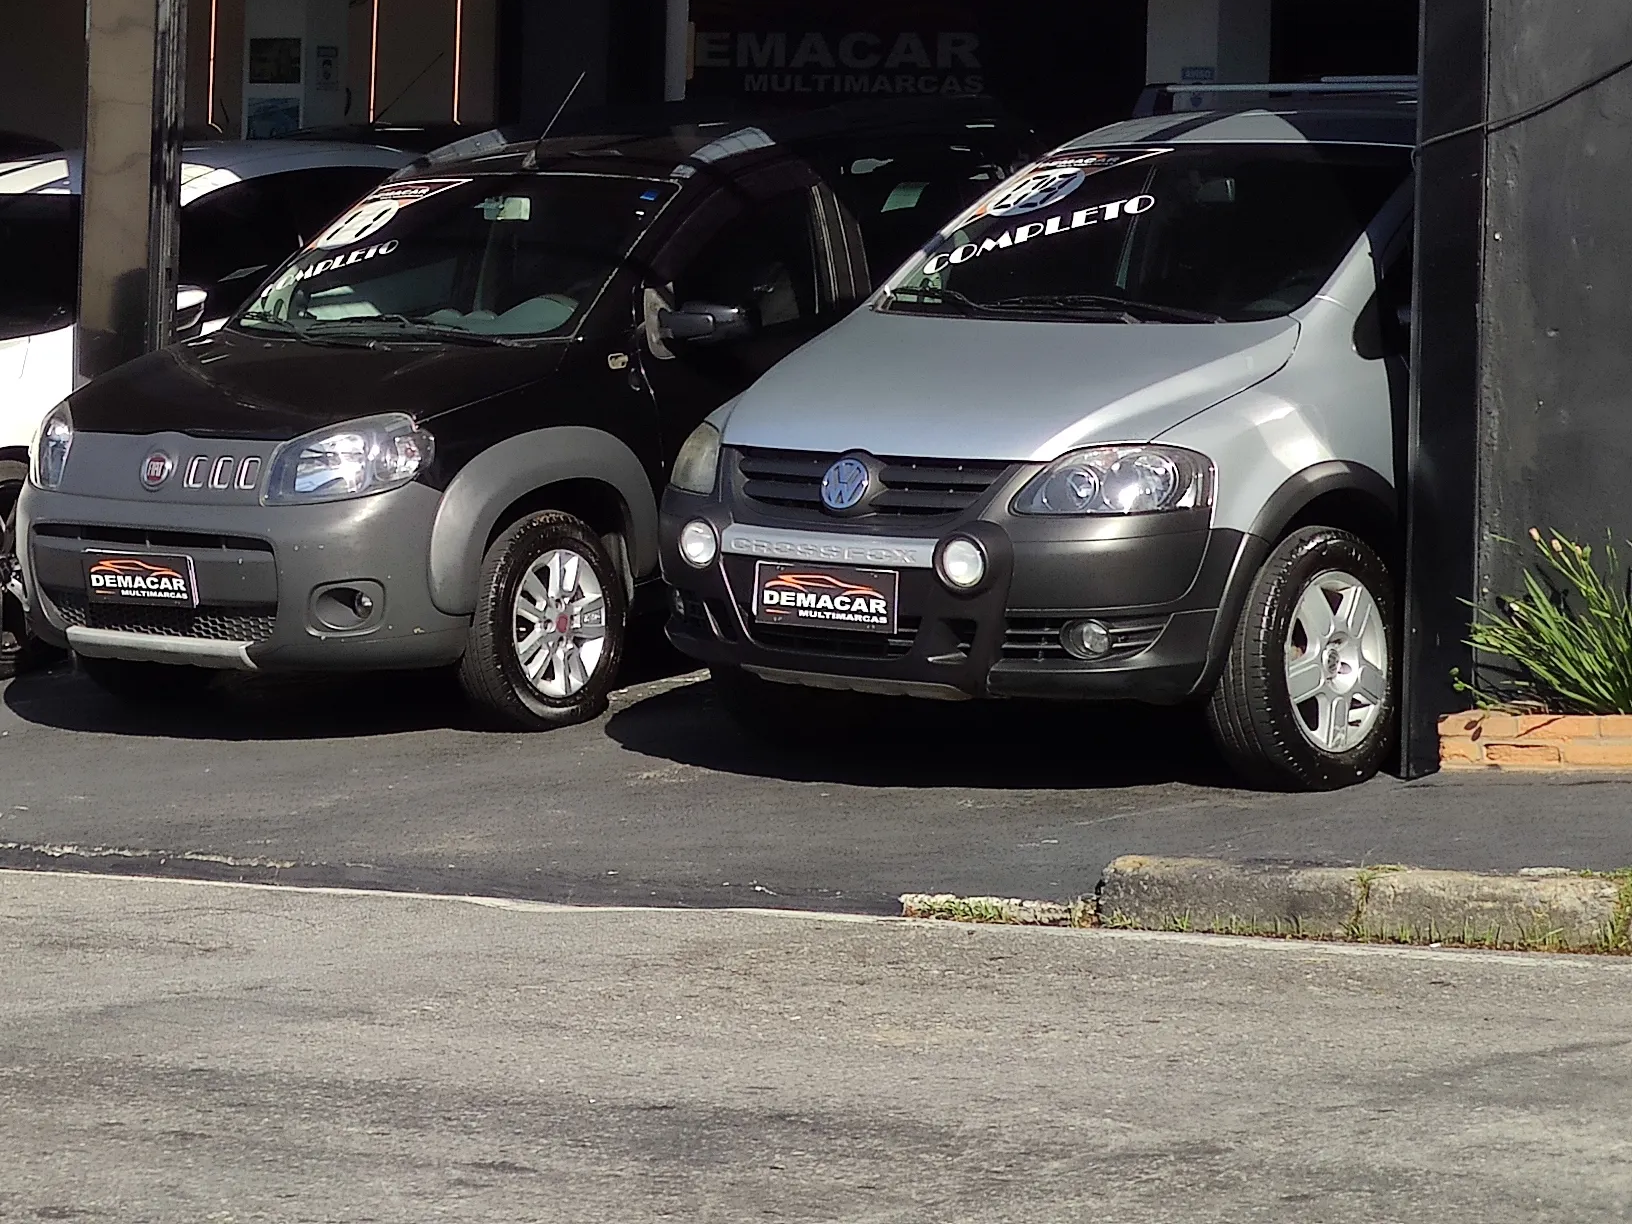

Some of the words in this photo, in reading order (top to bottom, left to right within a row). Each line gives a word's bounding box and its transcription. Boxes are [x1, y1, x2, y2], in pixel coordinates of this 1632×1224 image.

[694, 32, 983, 68] EMACAR
[744, 74, 985, 94] MULTIMARCAS
[923, 195, 1155, 275] COMPLETO
[730, 538, 917, 564] CROSSFOX
[90, 574, 186, 591] DEMACAR
[121, 588, 188, 600] MULTIMARCAS
[763, 589, 887, 614] DEMACAR
[798, 609, 888, 624] MULTIMARCAS
